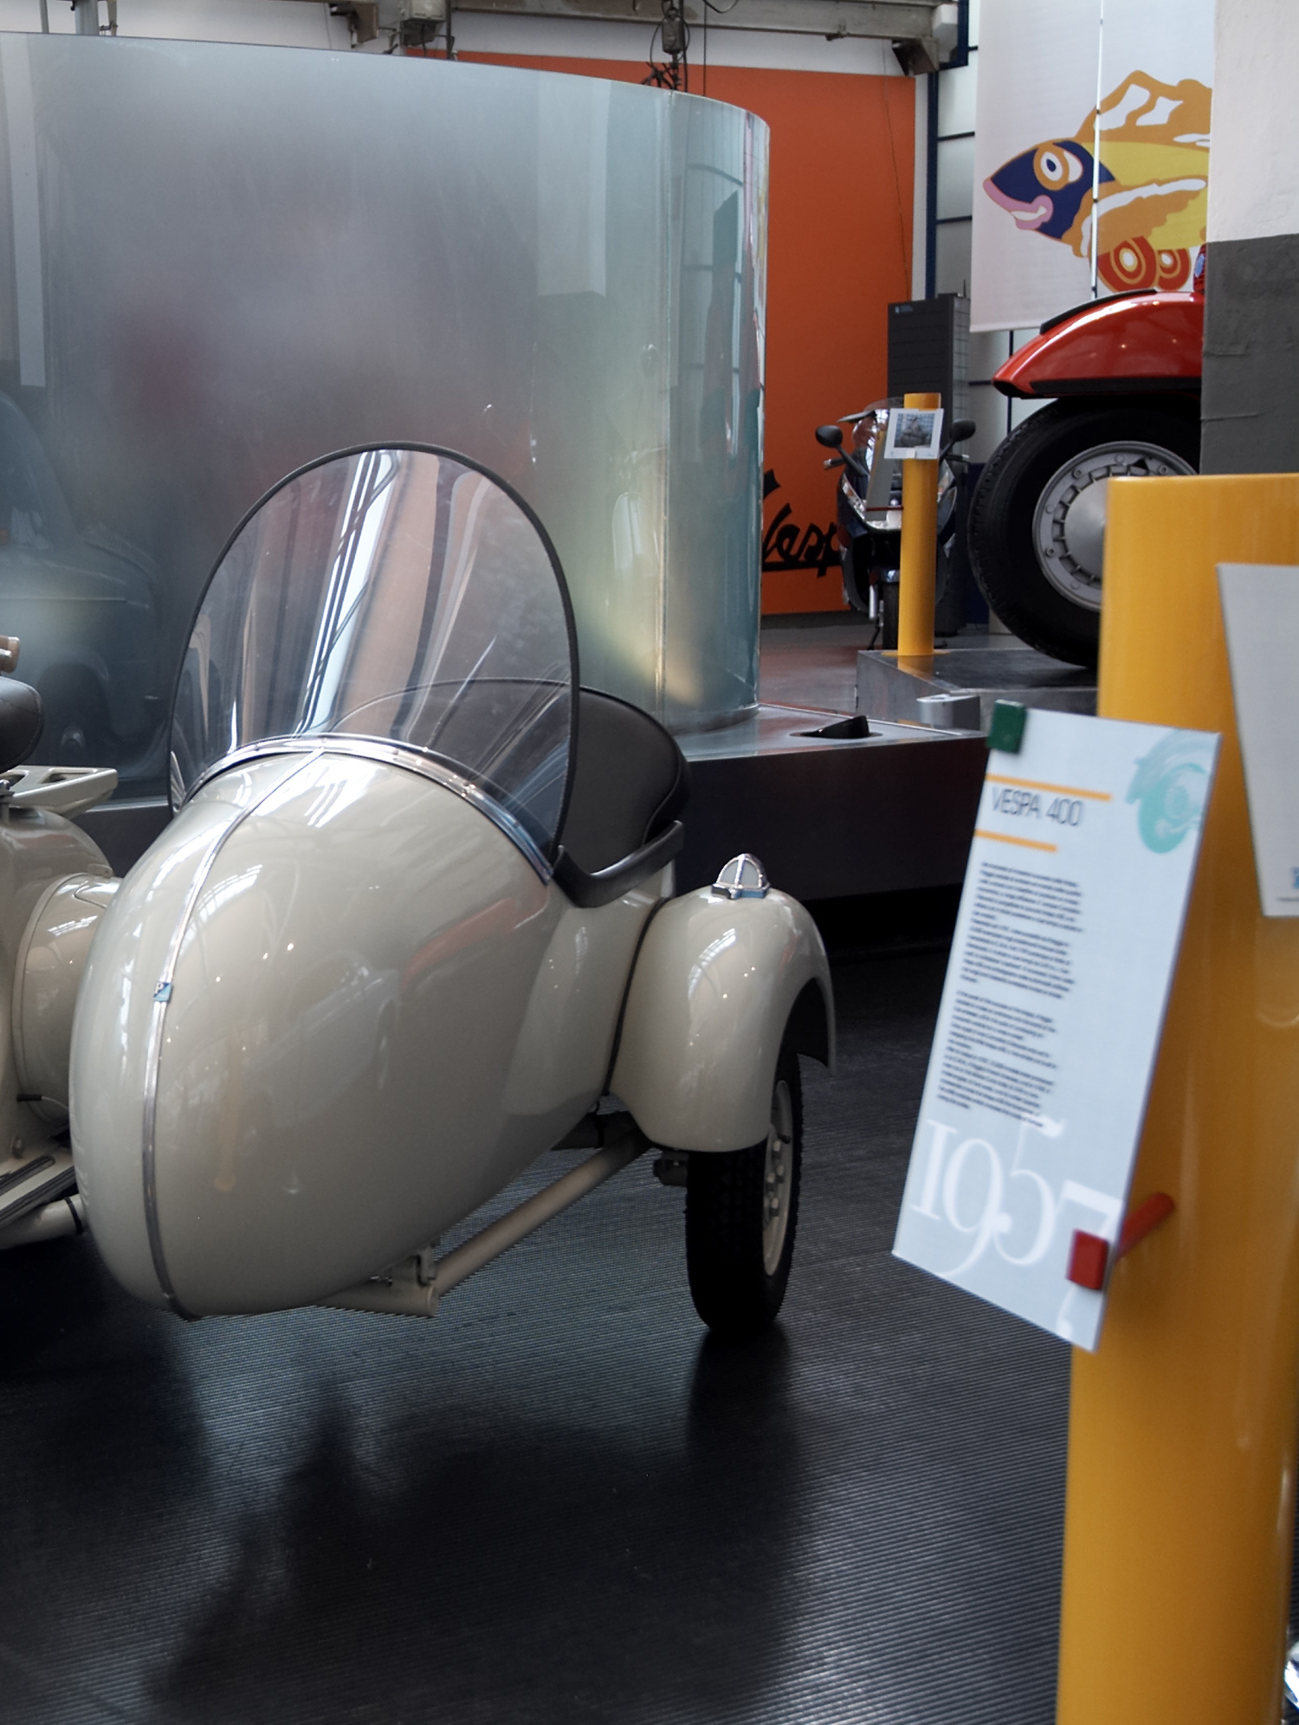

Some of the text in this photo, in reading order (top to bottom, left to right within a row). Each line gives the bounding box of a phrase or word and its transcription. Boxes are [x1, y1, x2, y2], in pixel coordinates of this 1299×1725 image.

[763, 469, 842, 578] Vesp
[992, 787, 1084, 827] VESPA 400
[909, 1115, 1123, 1338] 1957
